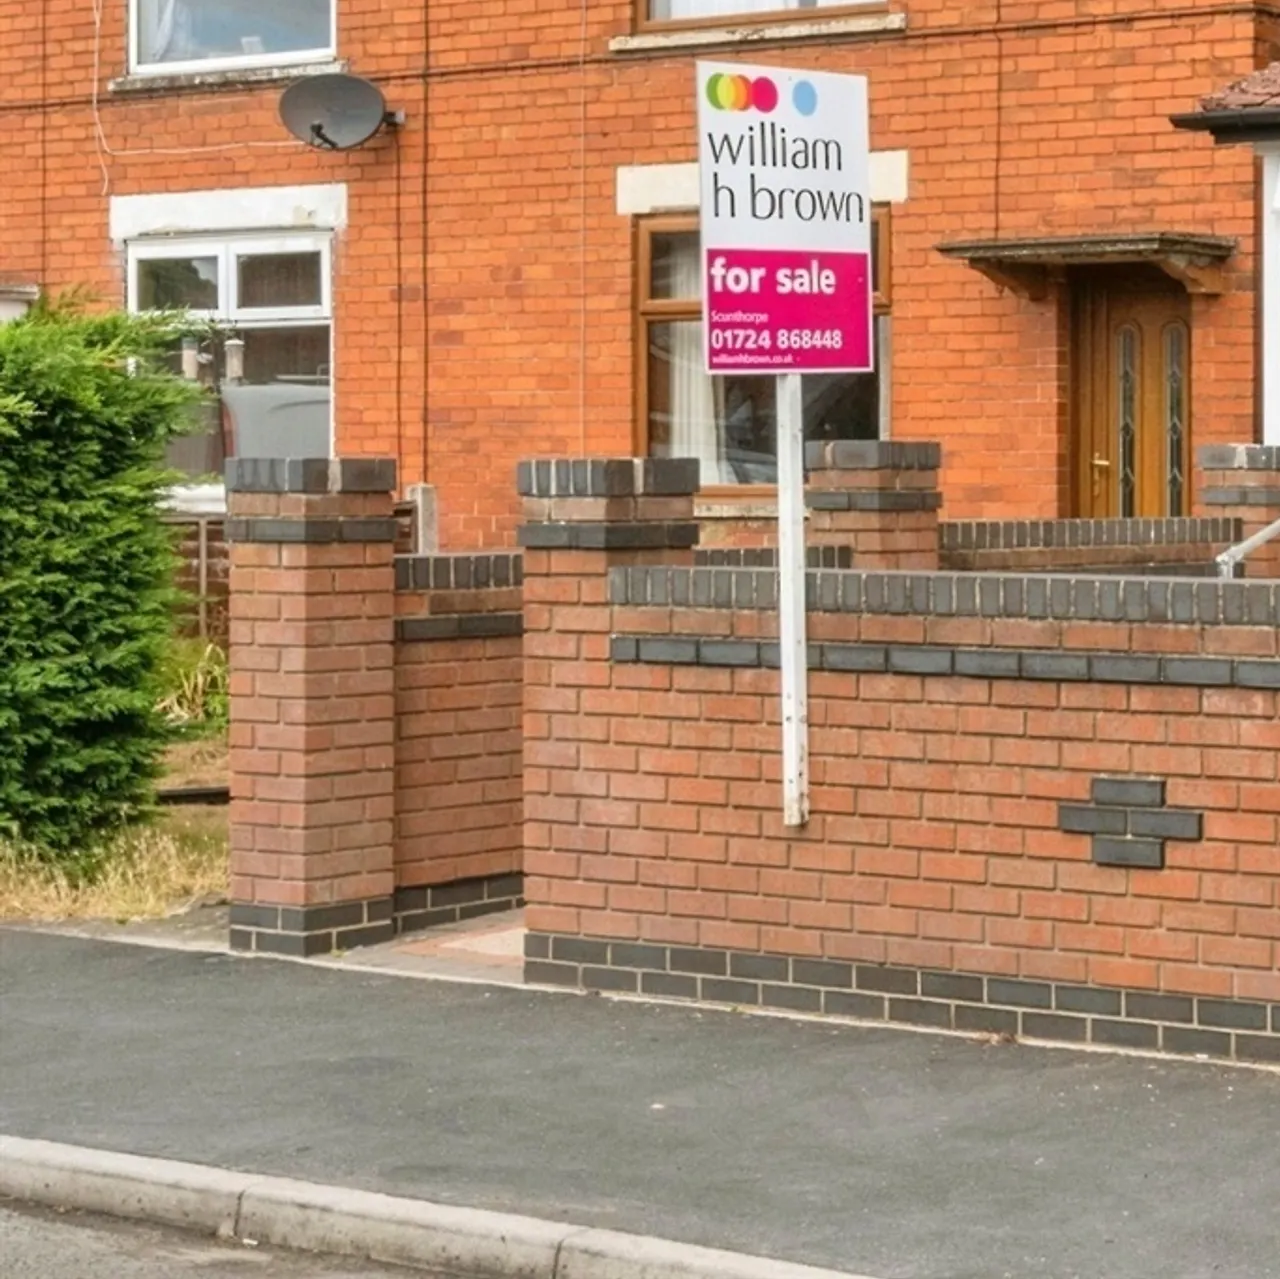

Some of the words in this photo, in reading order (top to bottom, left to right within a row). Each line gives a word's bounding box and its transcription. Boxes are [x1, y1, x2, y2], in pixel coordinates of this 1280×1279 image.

[708, 120, 843, 171] william
[713, 172, 736, 218] h
[750, 173, 864, 223] brown
[710, 256, 766, 294] for
[775, 260, 836, 295] sale
[711, 310, 769, 325] Scunthorpe
[711, 328, 771, 349] 01724
[776, 328, 843, 349] 868448
